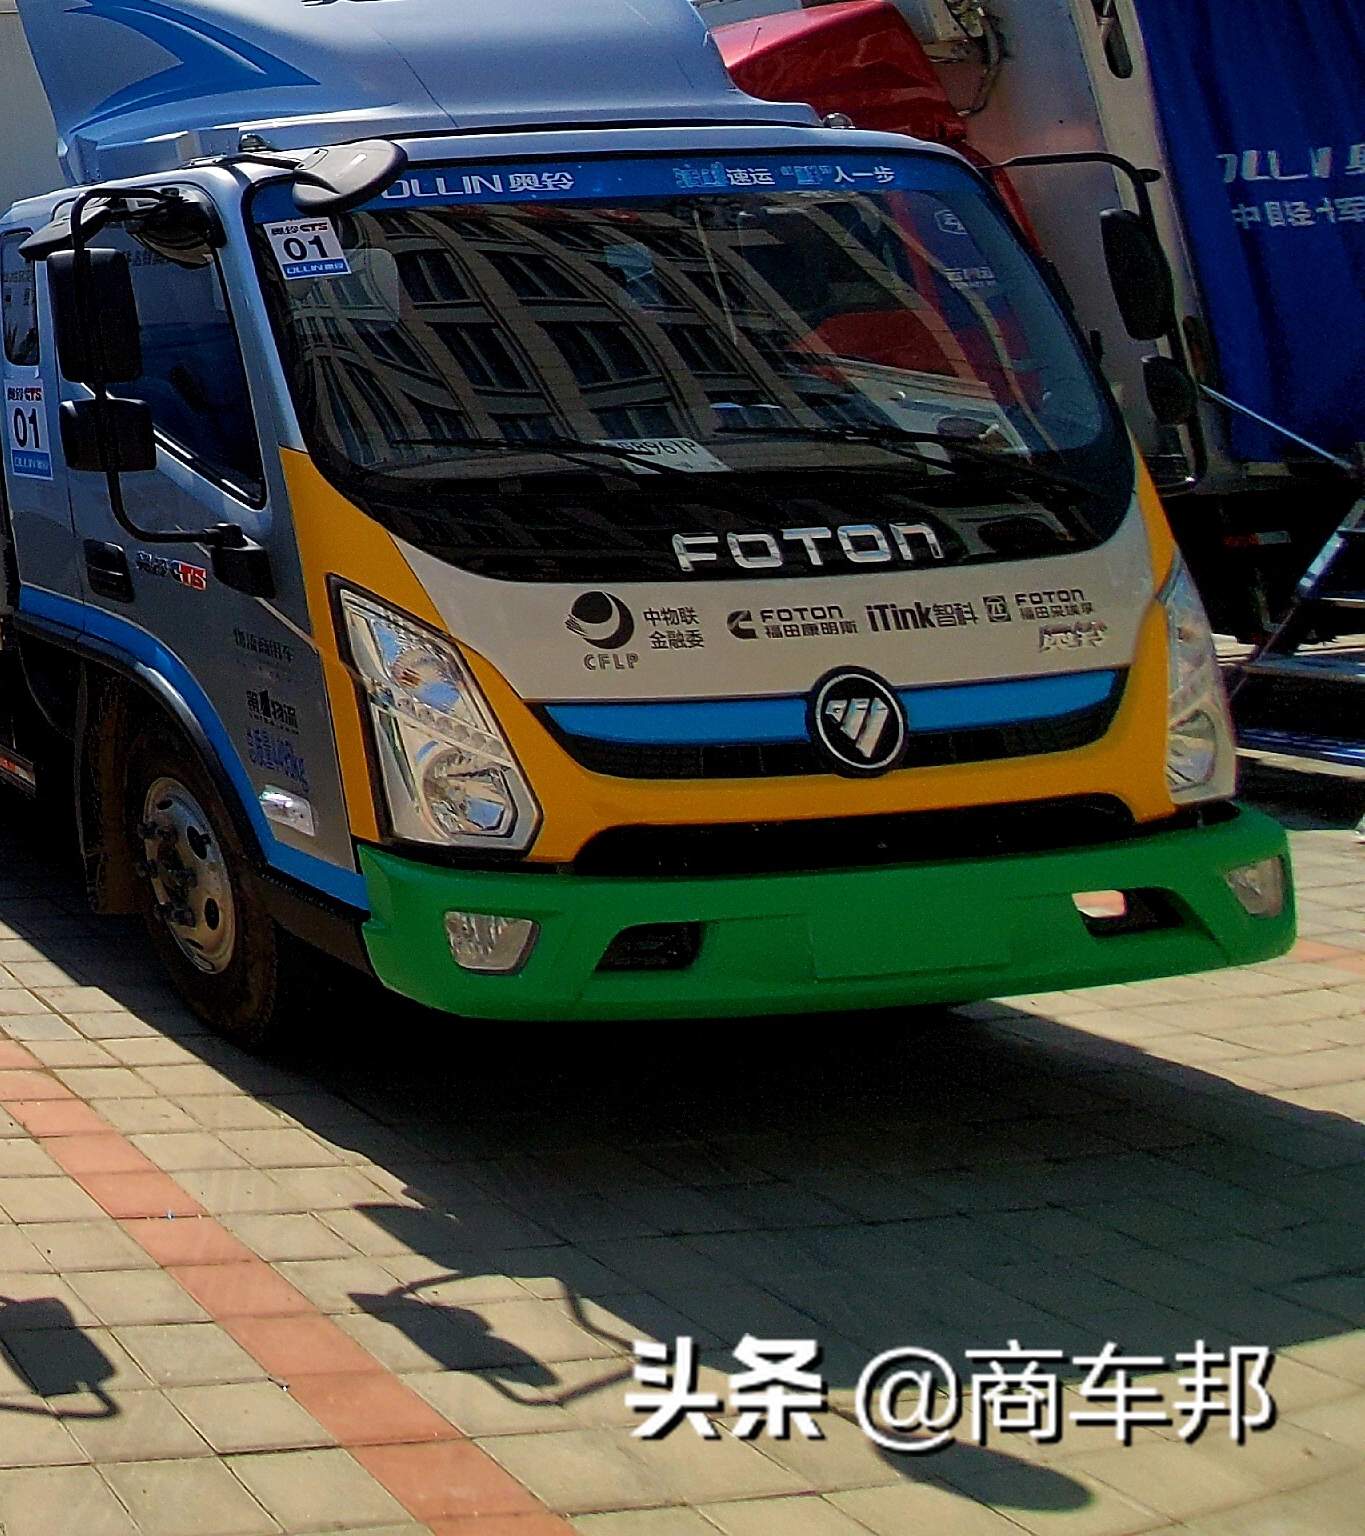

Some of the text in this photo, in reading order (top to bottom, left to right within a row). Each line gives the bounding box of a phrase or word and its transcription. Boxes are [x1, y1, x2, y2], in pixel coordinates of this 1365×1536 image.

[283, 234, 330, 262] 01
[13, 407, 40, 449] 01
[672, 522, 945, 572] FOTON
[1015, 589, 1086, 606] FOTON
[643, 606, 700, 627] 中物联
[759, 605, 844, 623] FOTON
[648, 629, 706, 650] 金融委
[583, 652, 640, 671] CFLP
